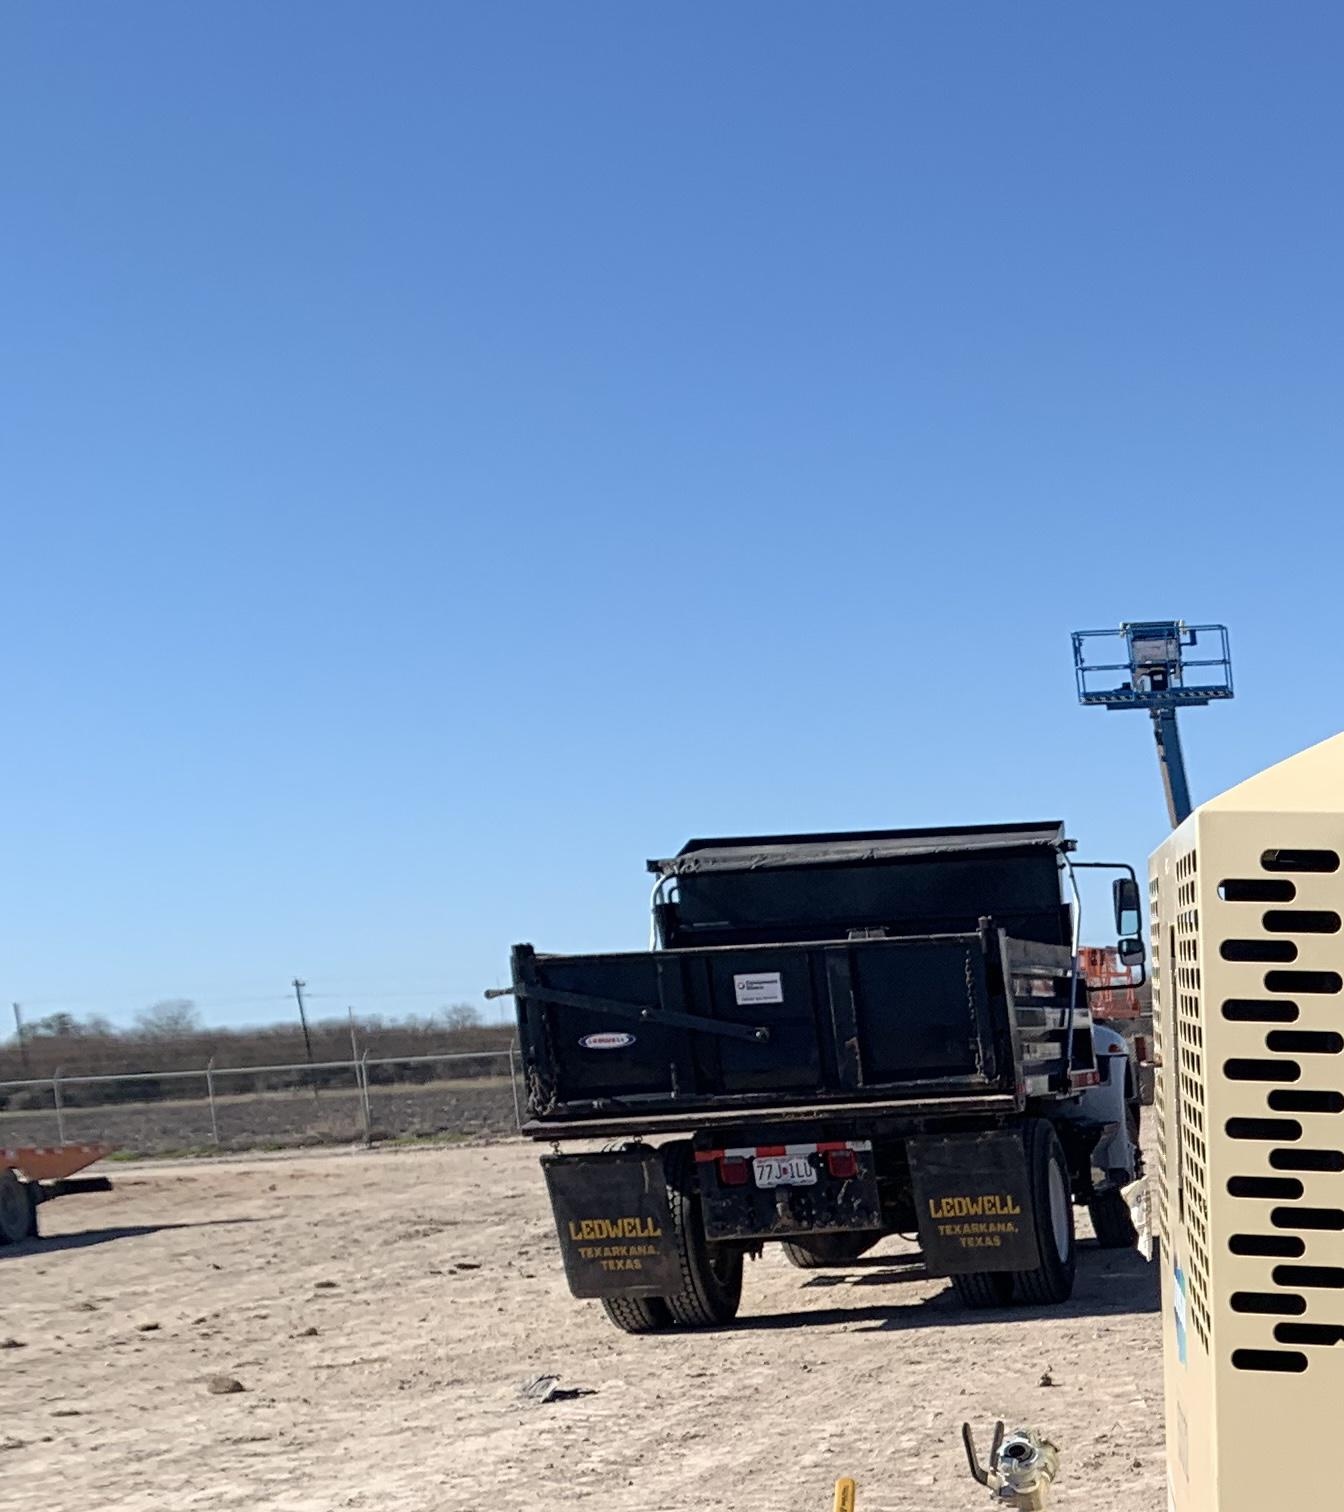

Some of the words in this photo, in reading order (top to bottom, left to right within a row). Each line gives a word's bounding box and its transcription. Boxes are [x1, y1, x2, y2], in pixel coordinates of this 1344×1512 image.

[928, 1195, 1021, 1218] LEDWELL
[568, 1216, 662, 1241] LEDWELL
[960, 1235, 1002, 1248] TEXAS
[600, 1258, 643, 1271] TEXAS
